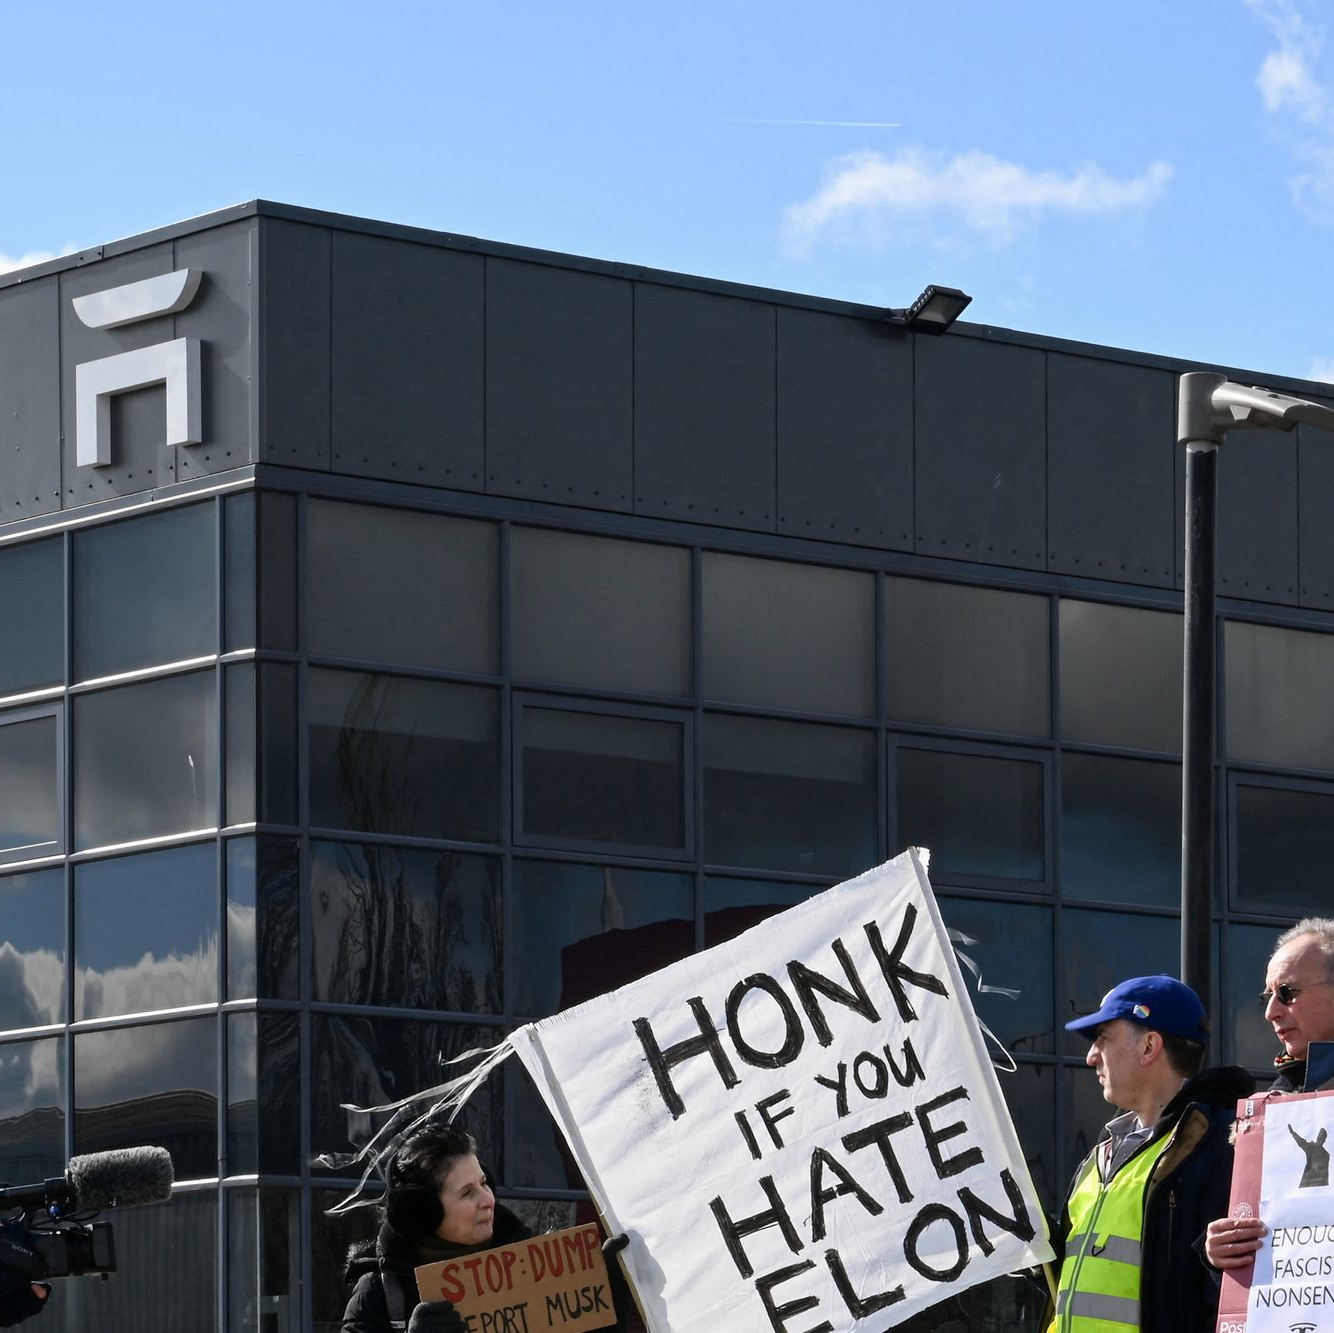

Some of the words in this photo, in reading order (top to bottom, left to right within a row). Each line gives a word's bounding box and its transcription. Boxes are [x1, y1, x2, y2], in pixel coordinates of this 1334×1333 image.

[632, 903, 950, 1121] HONK
[733, 1089, 796, 1161] IF
[814, 1039, 926, 1118] YOU
[708, 1086, 985, 1280] HATE
[546, 1285, 610, 1326] MUSK
